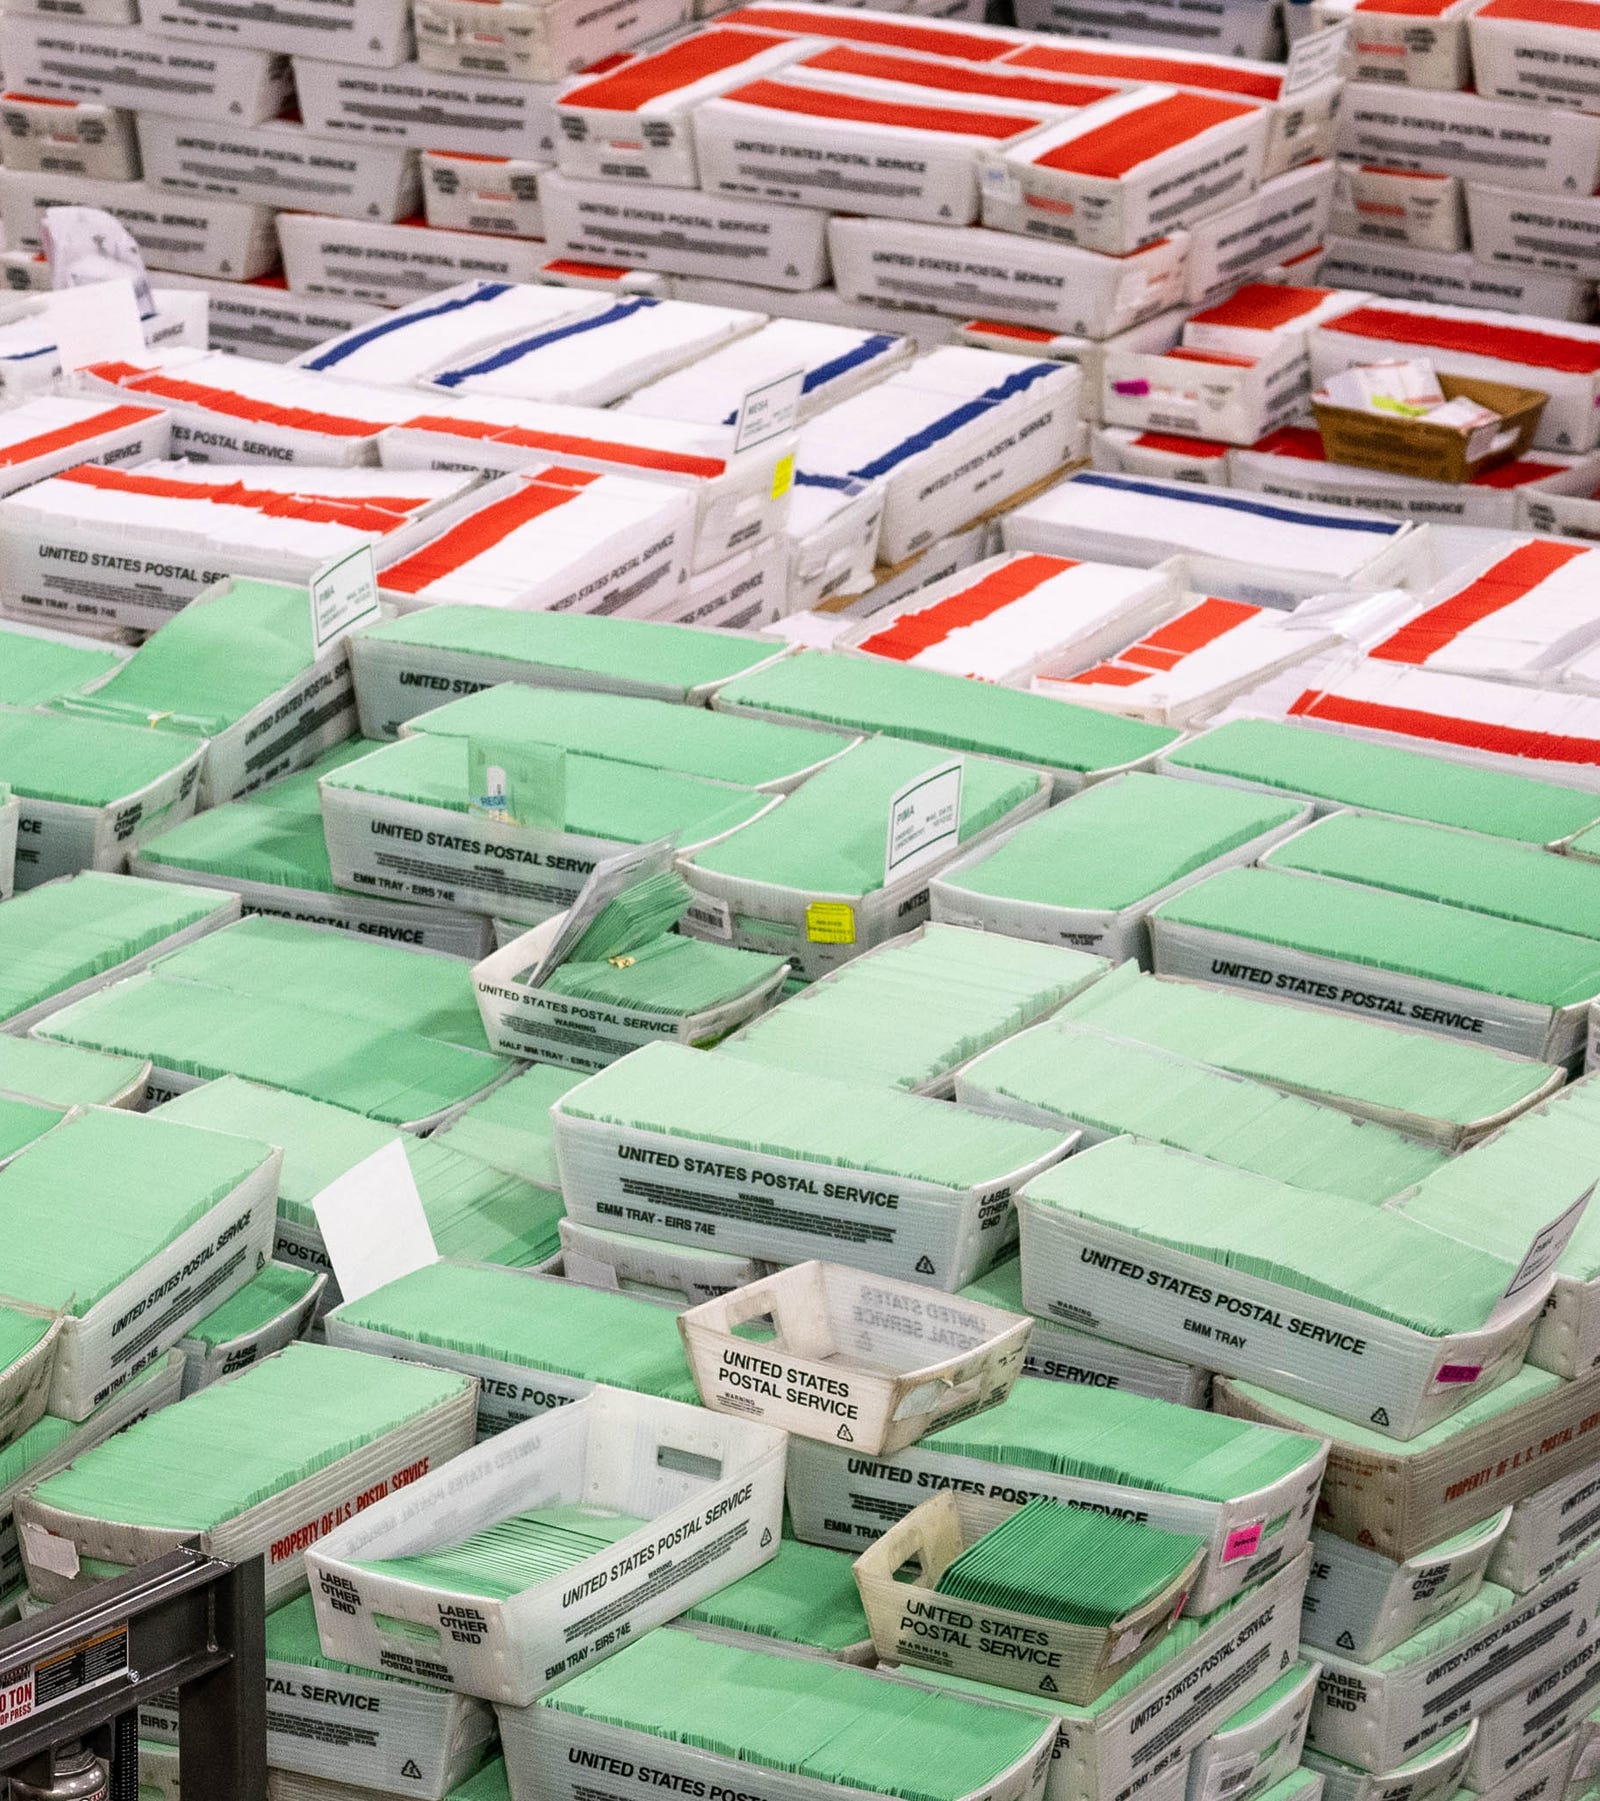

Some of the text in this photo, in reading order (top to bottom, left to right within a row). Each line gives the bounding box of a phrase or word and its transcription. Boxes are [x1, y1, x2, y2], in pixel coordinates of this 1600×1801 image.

[339, 80, 524, 107] UNITED STATES POSTAL SERVICE
[1354, 111, 1551, 145] UNITED STATES POSTAL SERVICE
[735, 142, 925, 173] UNITED STATES POSTAL SERVICE
[919, 412, 1052, 500] UNITED STATES POSTAL SERVICE
[39, 546, 197, 582] UNITED STATES POSTAL
[897, 805, 914, 825] PIMA
[372, 821, 423, 842] UNITED
[427, 832, 480, 854] STATES
[484, 844, 541, 865] POSTAL
[479, 983, 677, 1033] UNITED STATES POSTAL SERVICE
[1212, 960, 1483, 1033] UNITED STATES POSTAL SERVICE
[619, 1145, 899, 1209] UNITED STATES POSTAL SERVICE
[112, 1209, 251, 1337] UNITED STATES POSTAL SERVICE
[1081, 1248, 1366, 1355] UNITED STATES POSTAL SERVICE
[1184, 1319, 1246, 1348] EMM TRAY
[719, 1368, 858, 1419] POSTAL SERVICE
[724, 1350, 848, 1397] UNITED STATES
[271, 1520, 318, 1564] PROPERTY
[322, 1512, 333, 1535] OF
[391, 1457, 429, 1491] SERVICE
[563, 1483, 752, 1608] UNITED STATES POSTAL SERVICE
[318, 1569, 357, 1594] LABEL
[320, 1582, 361, 1606] OTHER
[331, 1598, 356, 1615] END
[438, 1604, 485, 1621] LABEL
[440, 1615, 488, 1634] OTHER
[907, 1600, 1048, 1646] UNITED STATES
[452, 1629, 482, 1645] END
[901, 1617, 1062, 1668] POSTAL SERVICE
[1130, 1605, 1275, 1734] UNITED STATES POSTAL SERVICE
[8, 1682, 32, 1709] TON
[10, 1703, 32, 1720] PRESS
